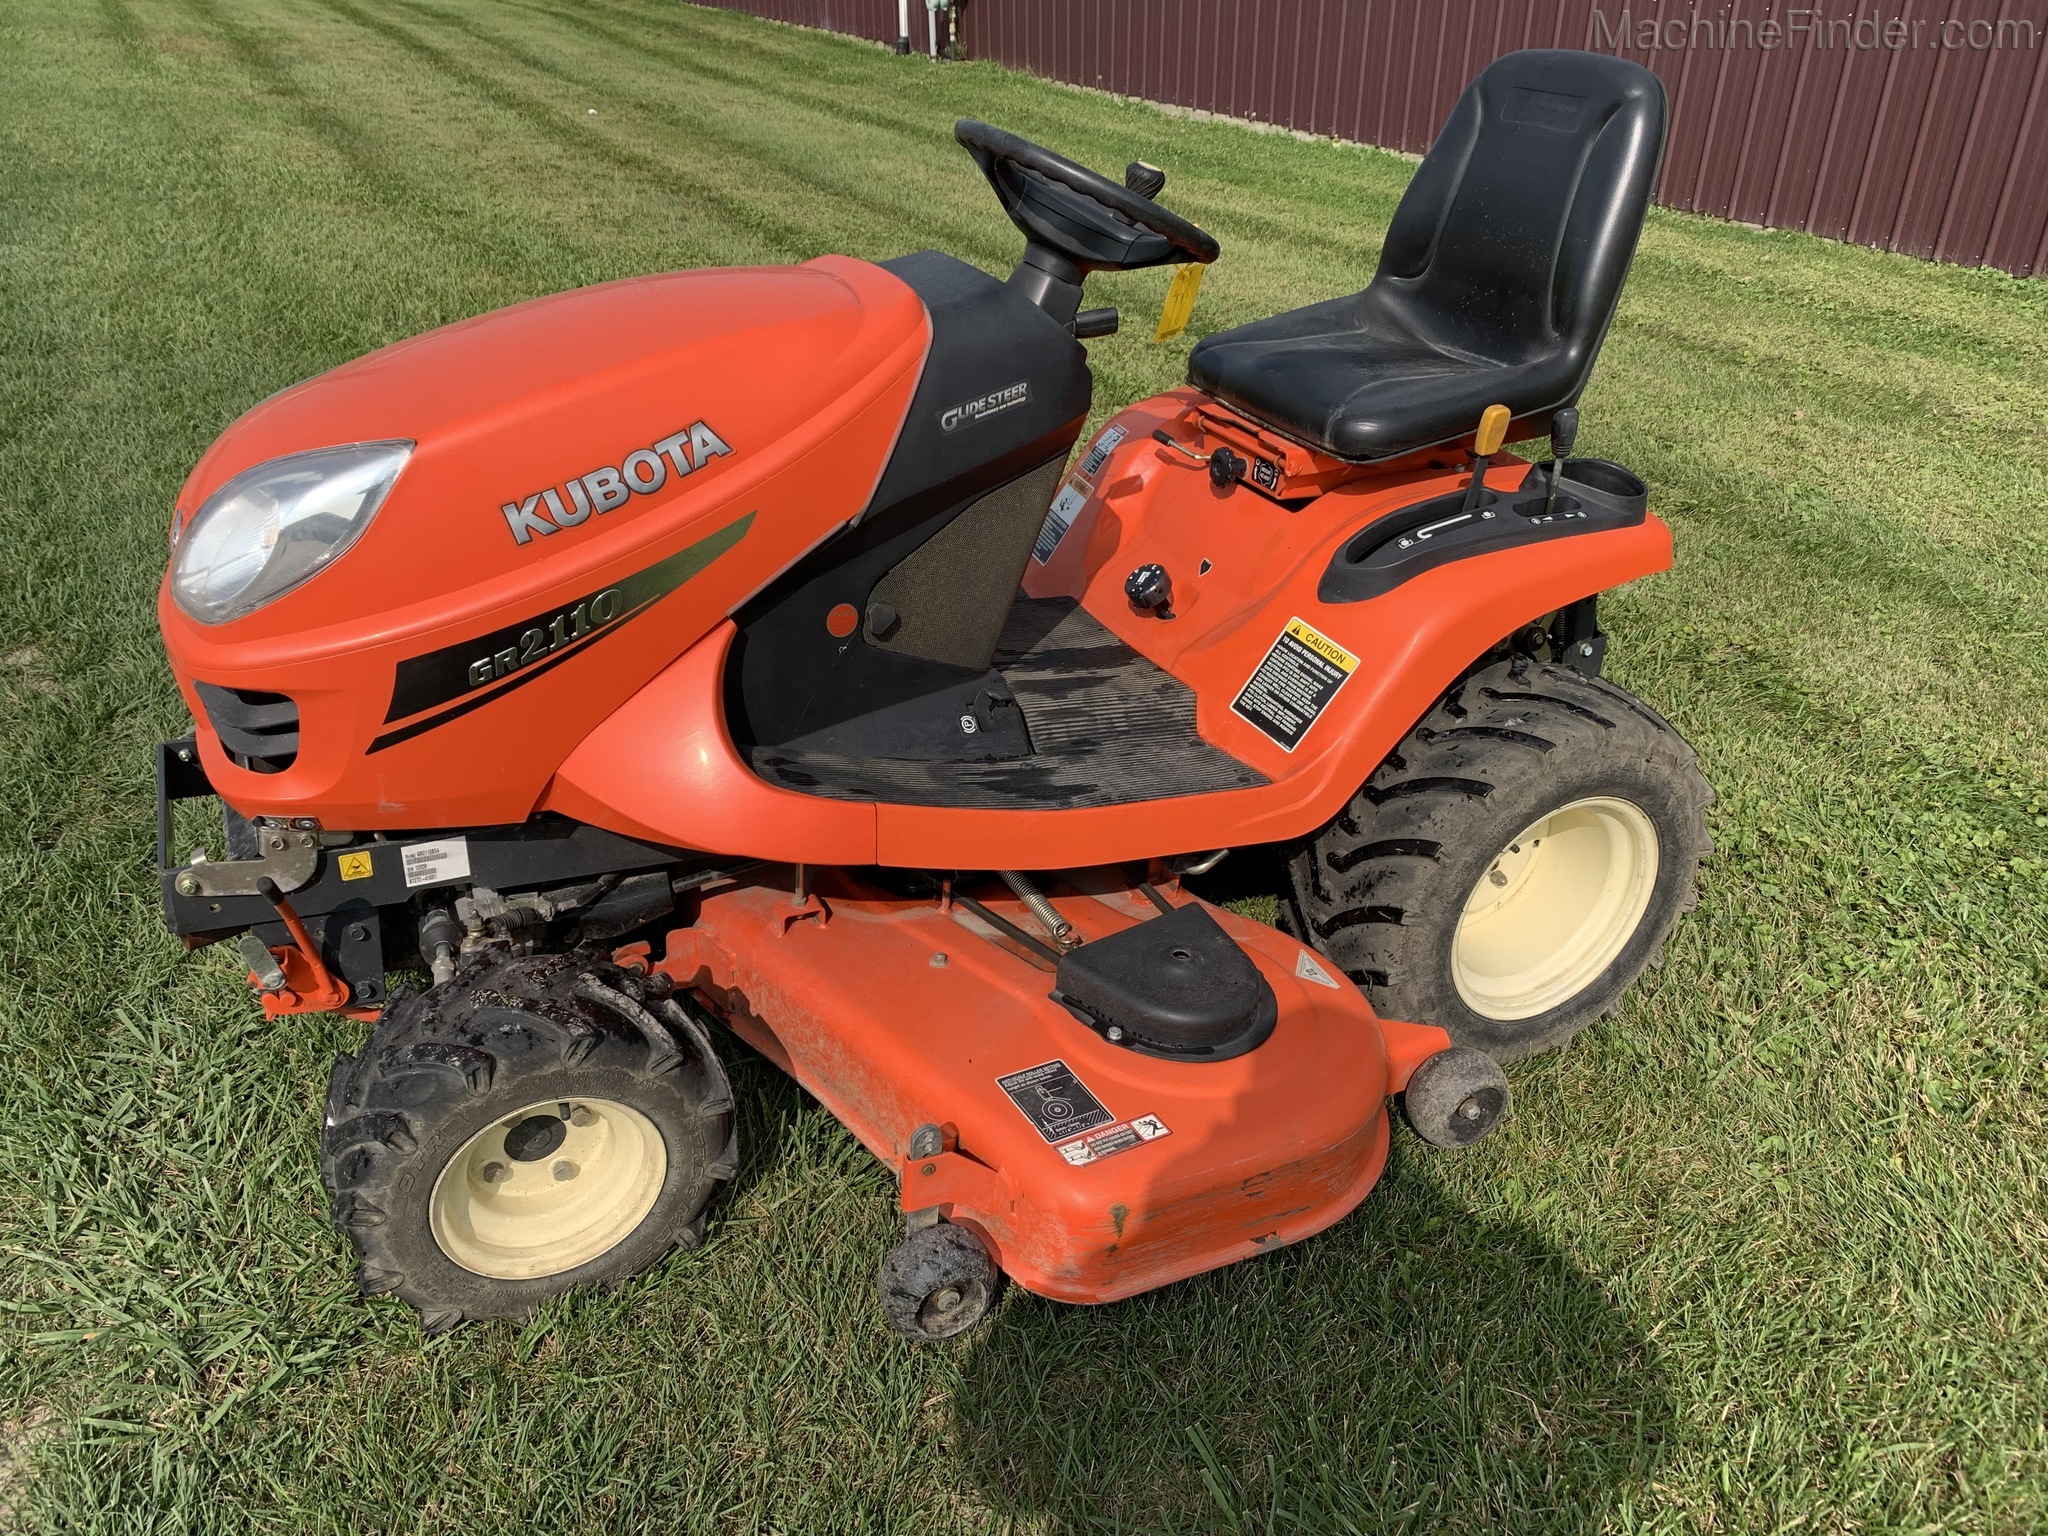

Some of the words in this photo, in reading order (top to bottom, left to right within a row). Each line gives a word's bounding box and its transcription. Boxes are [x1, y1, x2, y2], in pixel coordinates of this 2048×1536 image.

[501, 419, 736, 545] KUBOTA
[468, 588, 624, 687] GR2110
[1282, 636, 1290, 644] TO
[1288, 640, 1303, 653] AVOID
[1301, 649, 1326, 668] PERSONAL
[1324, 665, 1343, 680] INJURY
[1305, 633, 1346, 664] CAUTION
[1095, 1123, 1130, 1140] DANGER
